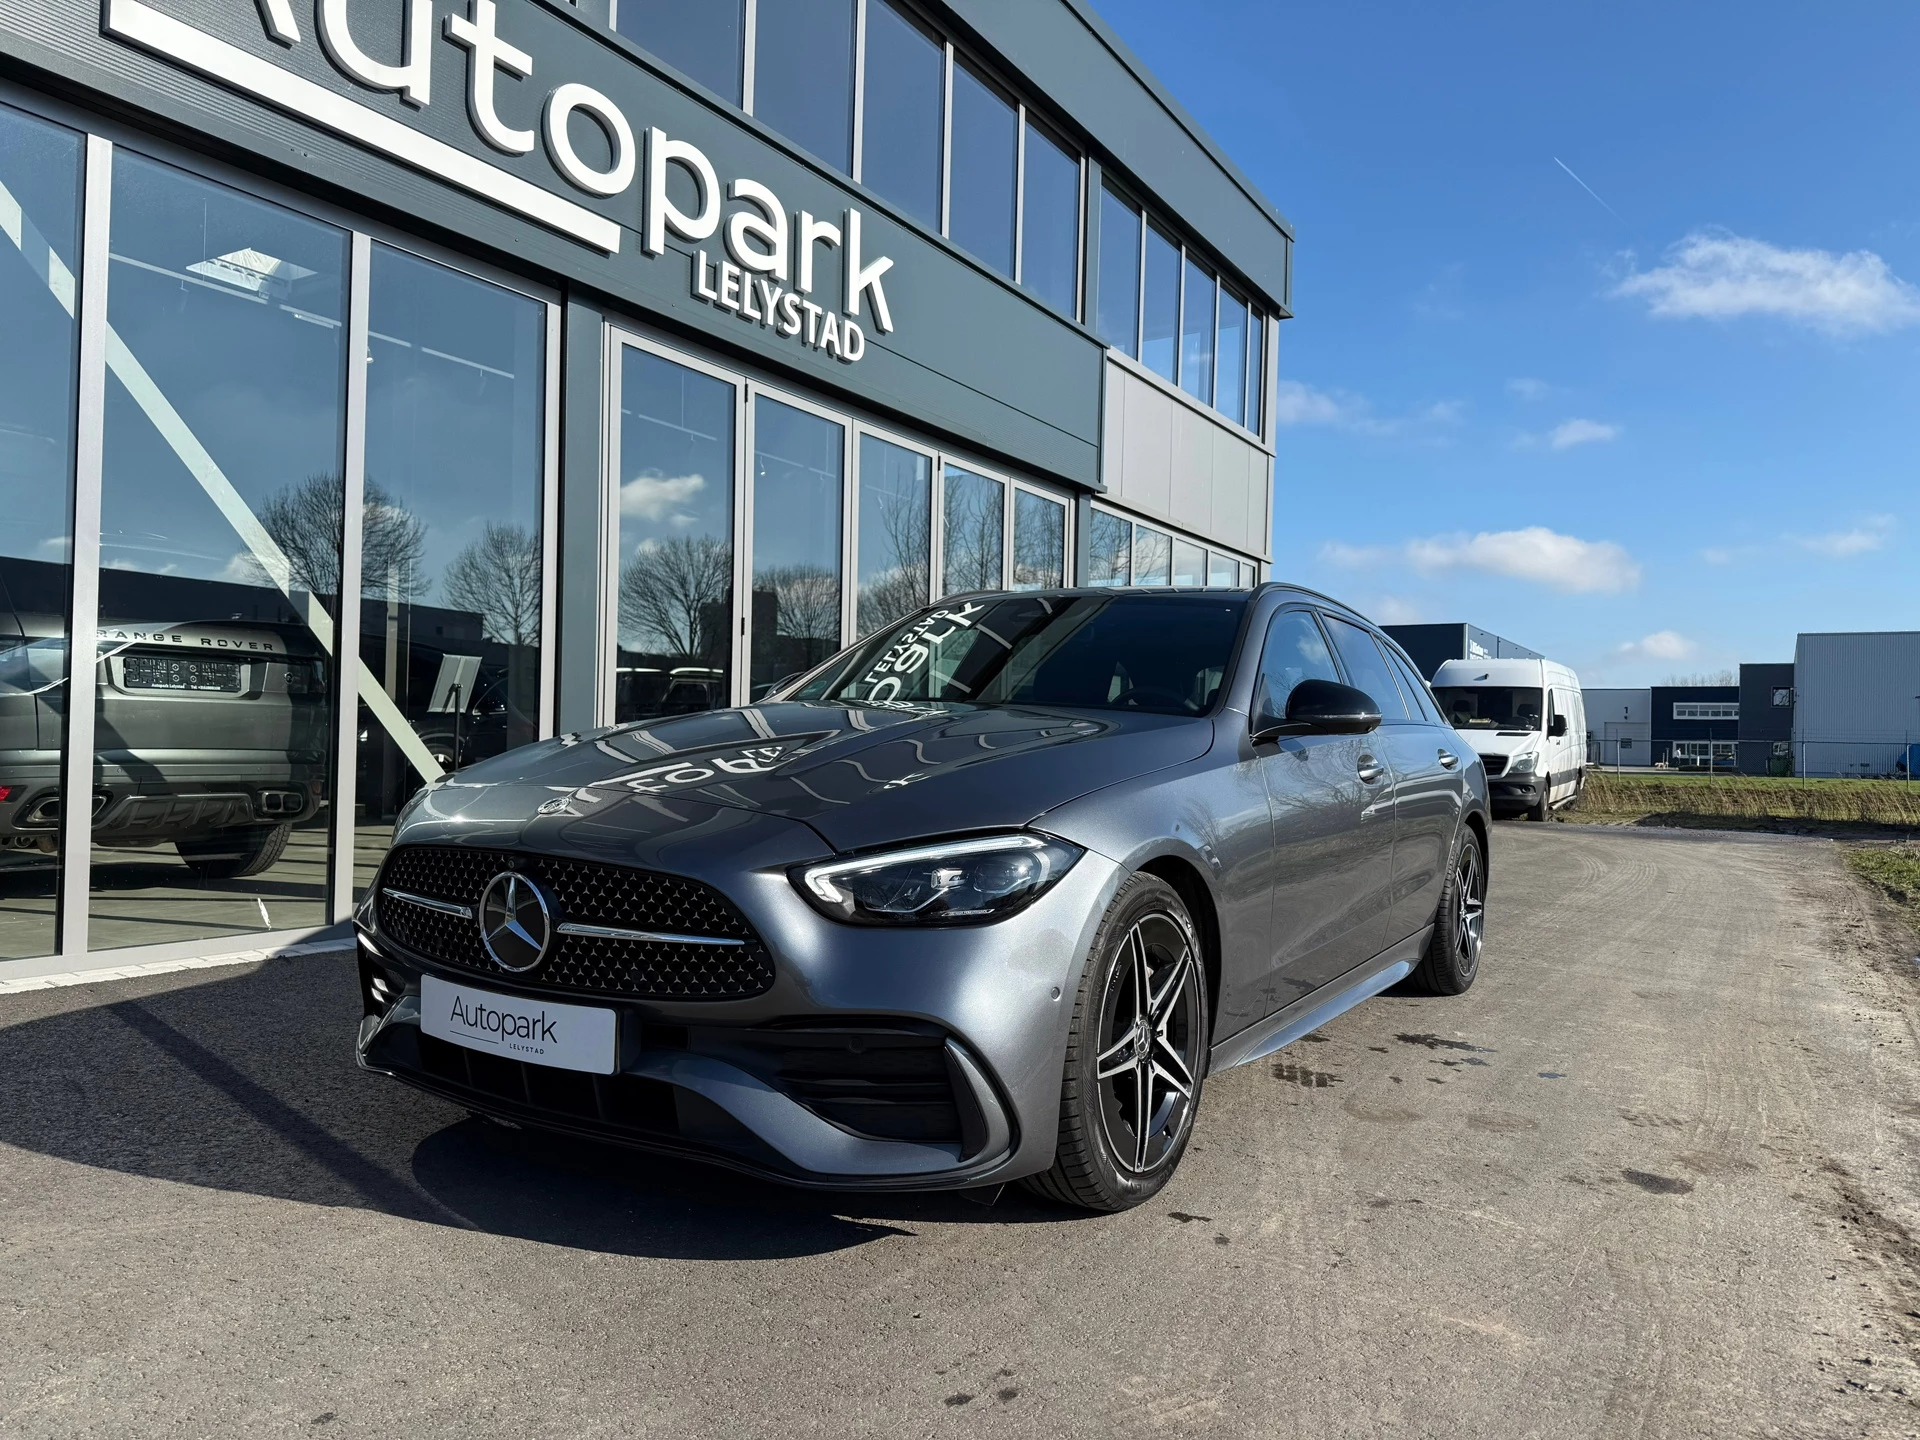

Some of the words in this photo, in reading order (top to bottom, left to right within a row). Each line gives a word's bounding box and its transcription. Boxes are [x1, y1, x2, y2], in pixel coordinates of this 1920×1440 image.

[250, 0, 895, 334] utopark
[691, 249, 866, 364] LELYSTAD
[96, 629, 183, 643] RANGE
[200, 637, 273, 651] ROVER
[450, 995, 558, 1044] Autopark
[509, 1043, 545, 1055] LELYSTAD
